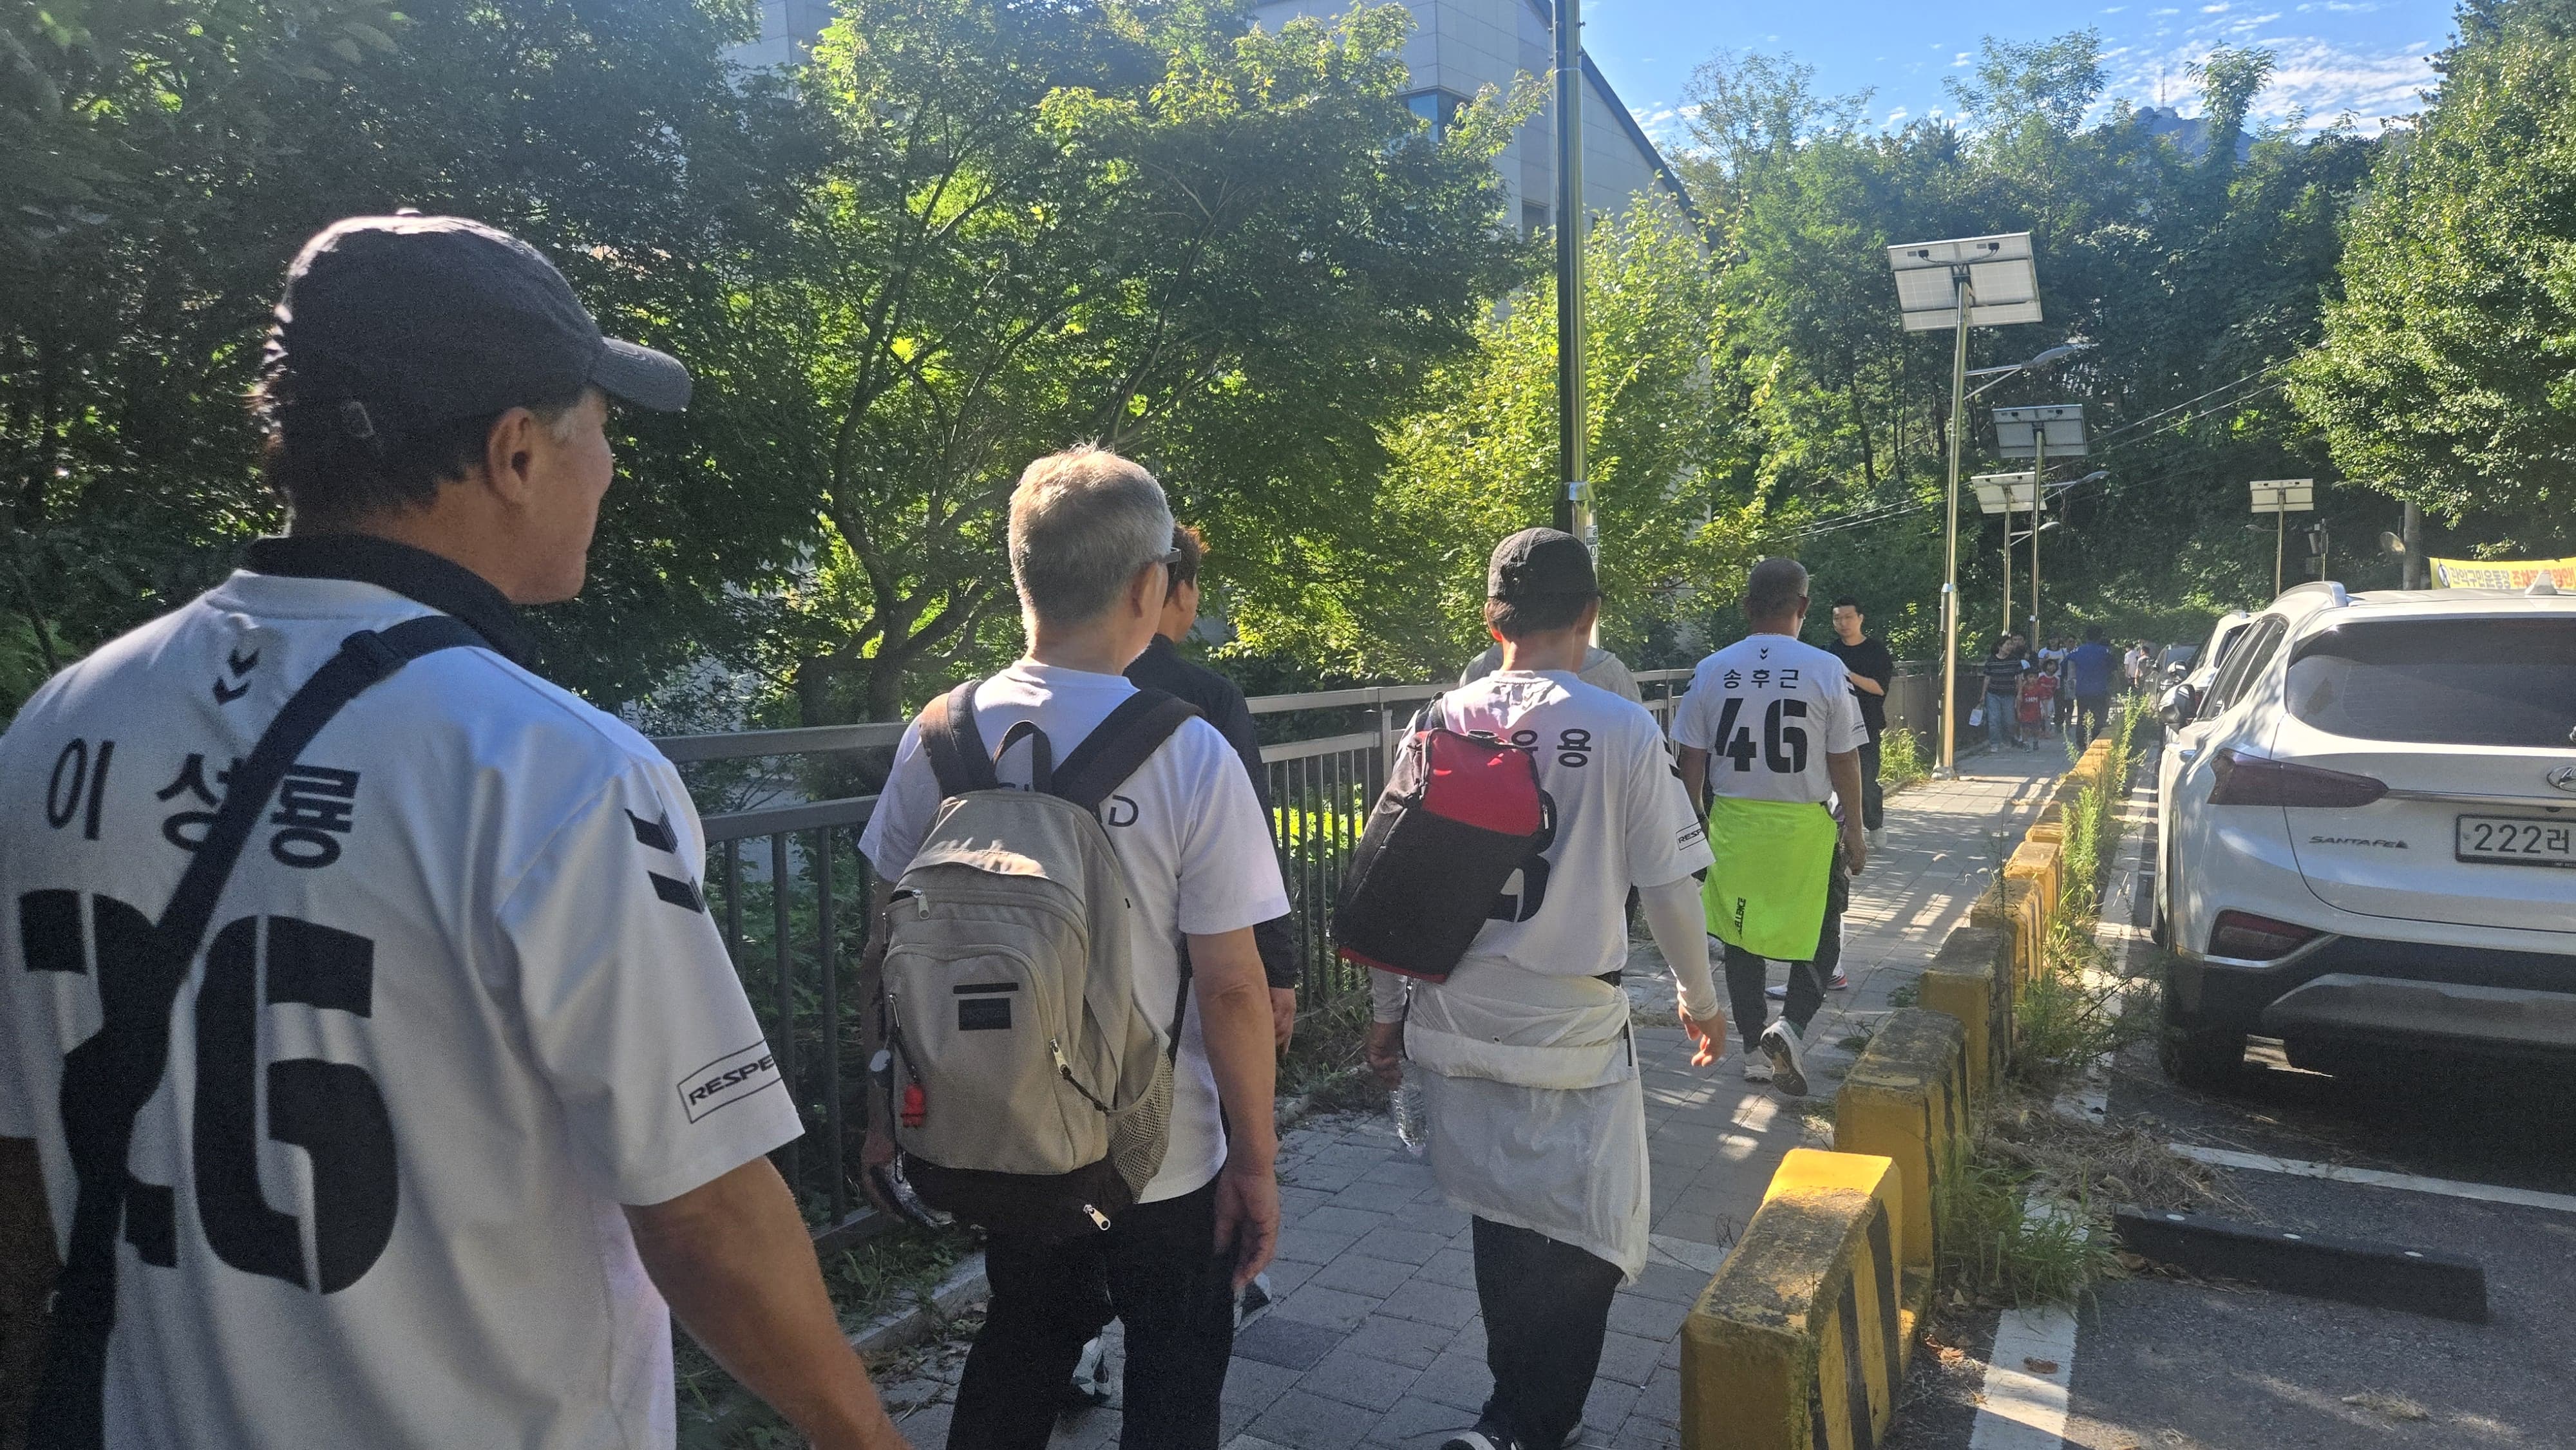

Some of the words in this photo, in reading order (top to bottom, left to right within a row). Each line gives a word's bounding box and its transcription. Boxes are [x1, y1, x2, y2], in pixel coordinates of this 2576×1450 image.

[2450, 567, 2512, 589] 관악구민운동장
[1724, 669, 1799, 689] 송후근
[1714, 698, 1808, 773] 46
[2474, 823, 2570, 854] 222러
